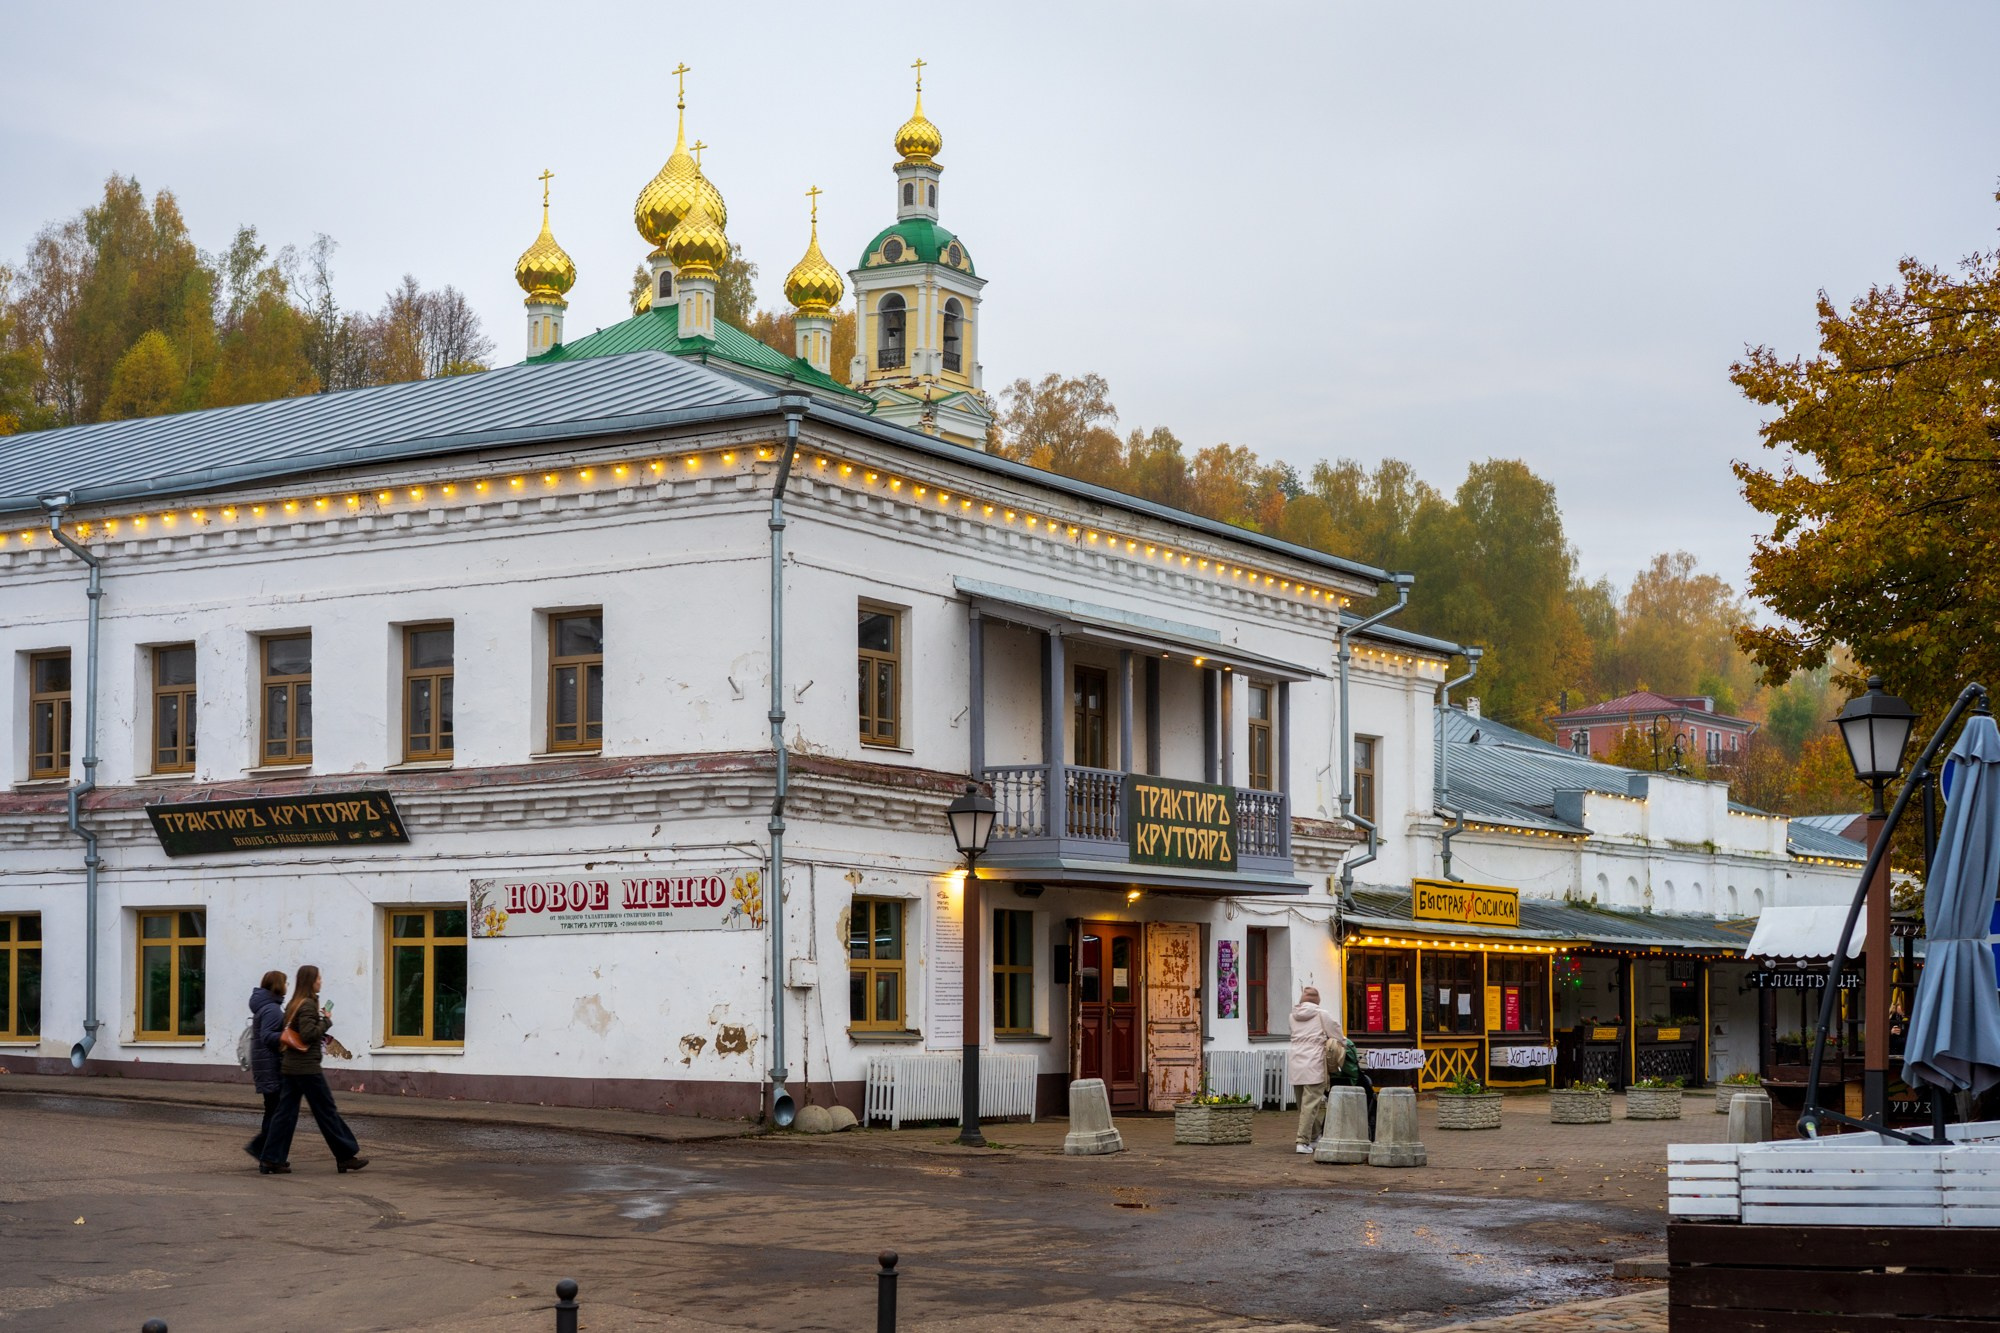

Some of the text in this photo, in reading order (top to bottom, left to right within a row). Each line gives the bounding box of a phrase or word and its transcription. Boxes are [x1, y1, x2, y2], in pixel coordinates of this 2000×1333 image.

[159, 800, 381, 833] ТРАКТИРЪ КРУТОЯРЪ
[1136, 785, 1231, 825] ТРАКТИРЪ
[1137, 822, 1232, 862] КРУТОЯРЪ
[504, 875, 727, 914] НОВОЕ МЕНЮ
[1420, 890, 1515, 918] БЫСТРАЯ СОСИСКА
[589, 921, 618, 929] КРУТОЯРЪ
[1759, 974, 1857, 987] ГЛИНТВН
[1368, 1047, 1424, 1068] ГЛИНТВЕЙНЫ
